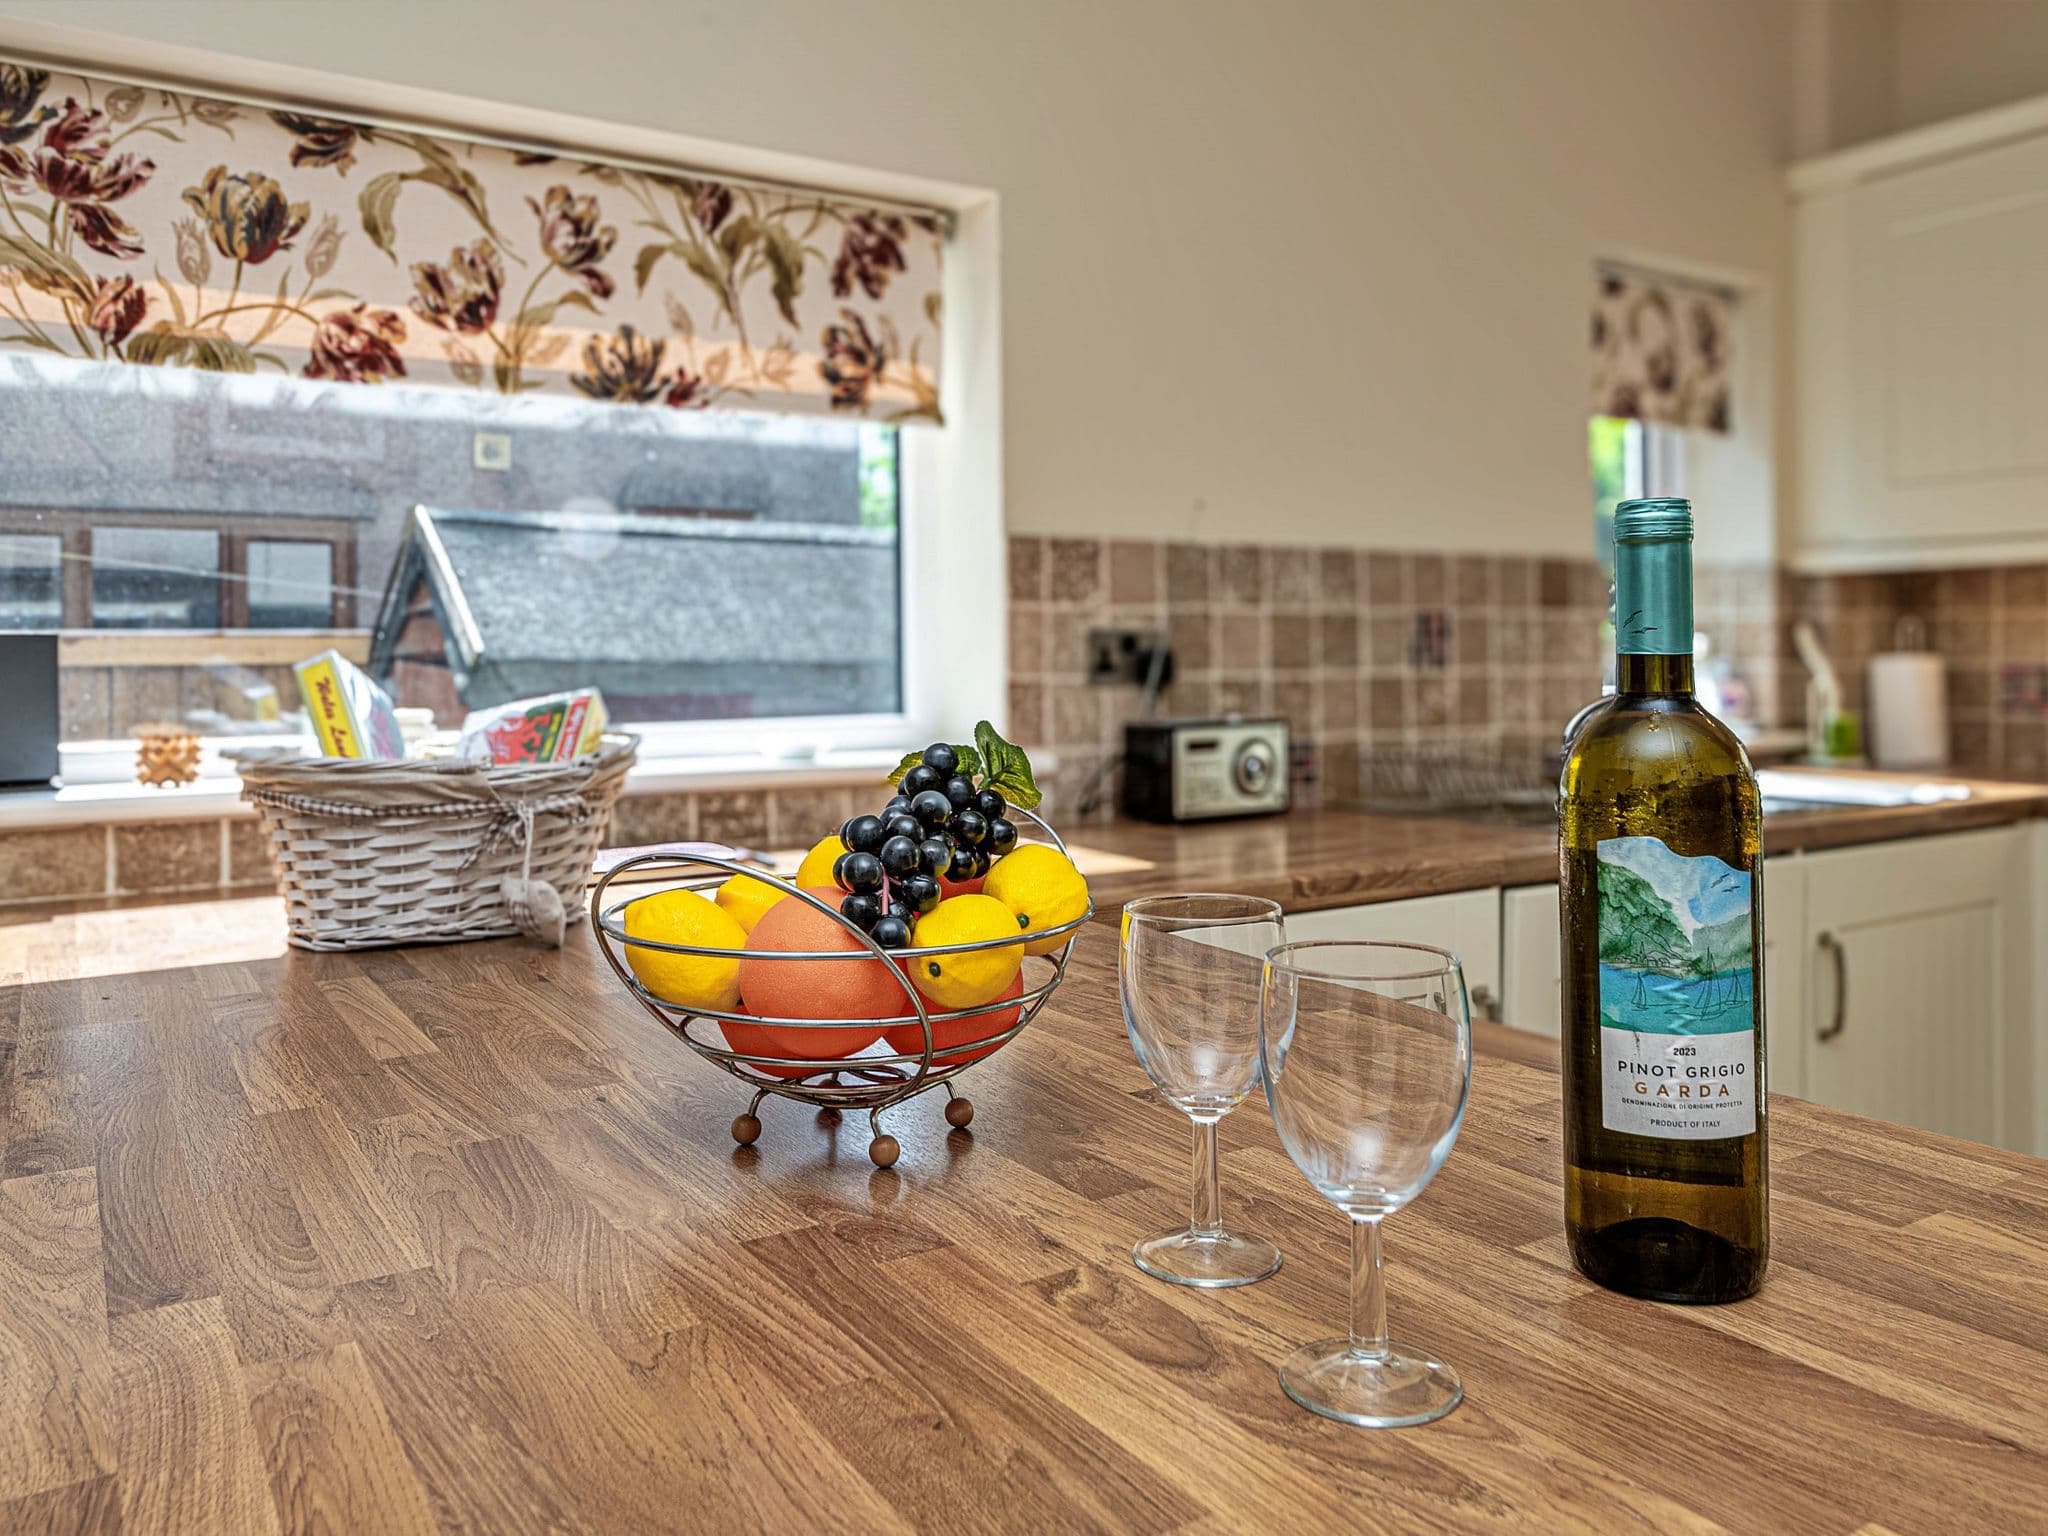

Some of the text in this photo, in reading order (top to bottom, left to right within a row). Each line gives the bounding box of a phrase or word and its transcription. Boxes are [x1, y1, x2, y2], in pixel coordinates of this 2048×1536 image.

[1673, 1048, 1696, 1056] 2023
[1618, 1060, 1745, 1078] PINOT GRIGIO
[1635, 1081, 1730, 1098] GARDA
[1621, 1097, 1676, 1110] DENOMINAZIONE
[1650, 1118, 1721, 1128] PRODUCT OF ITALY
